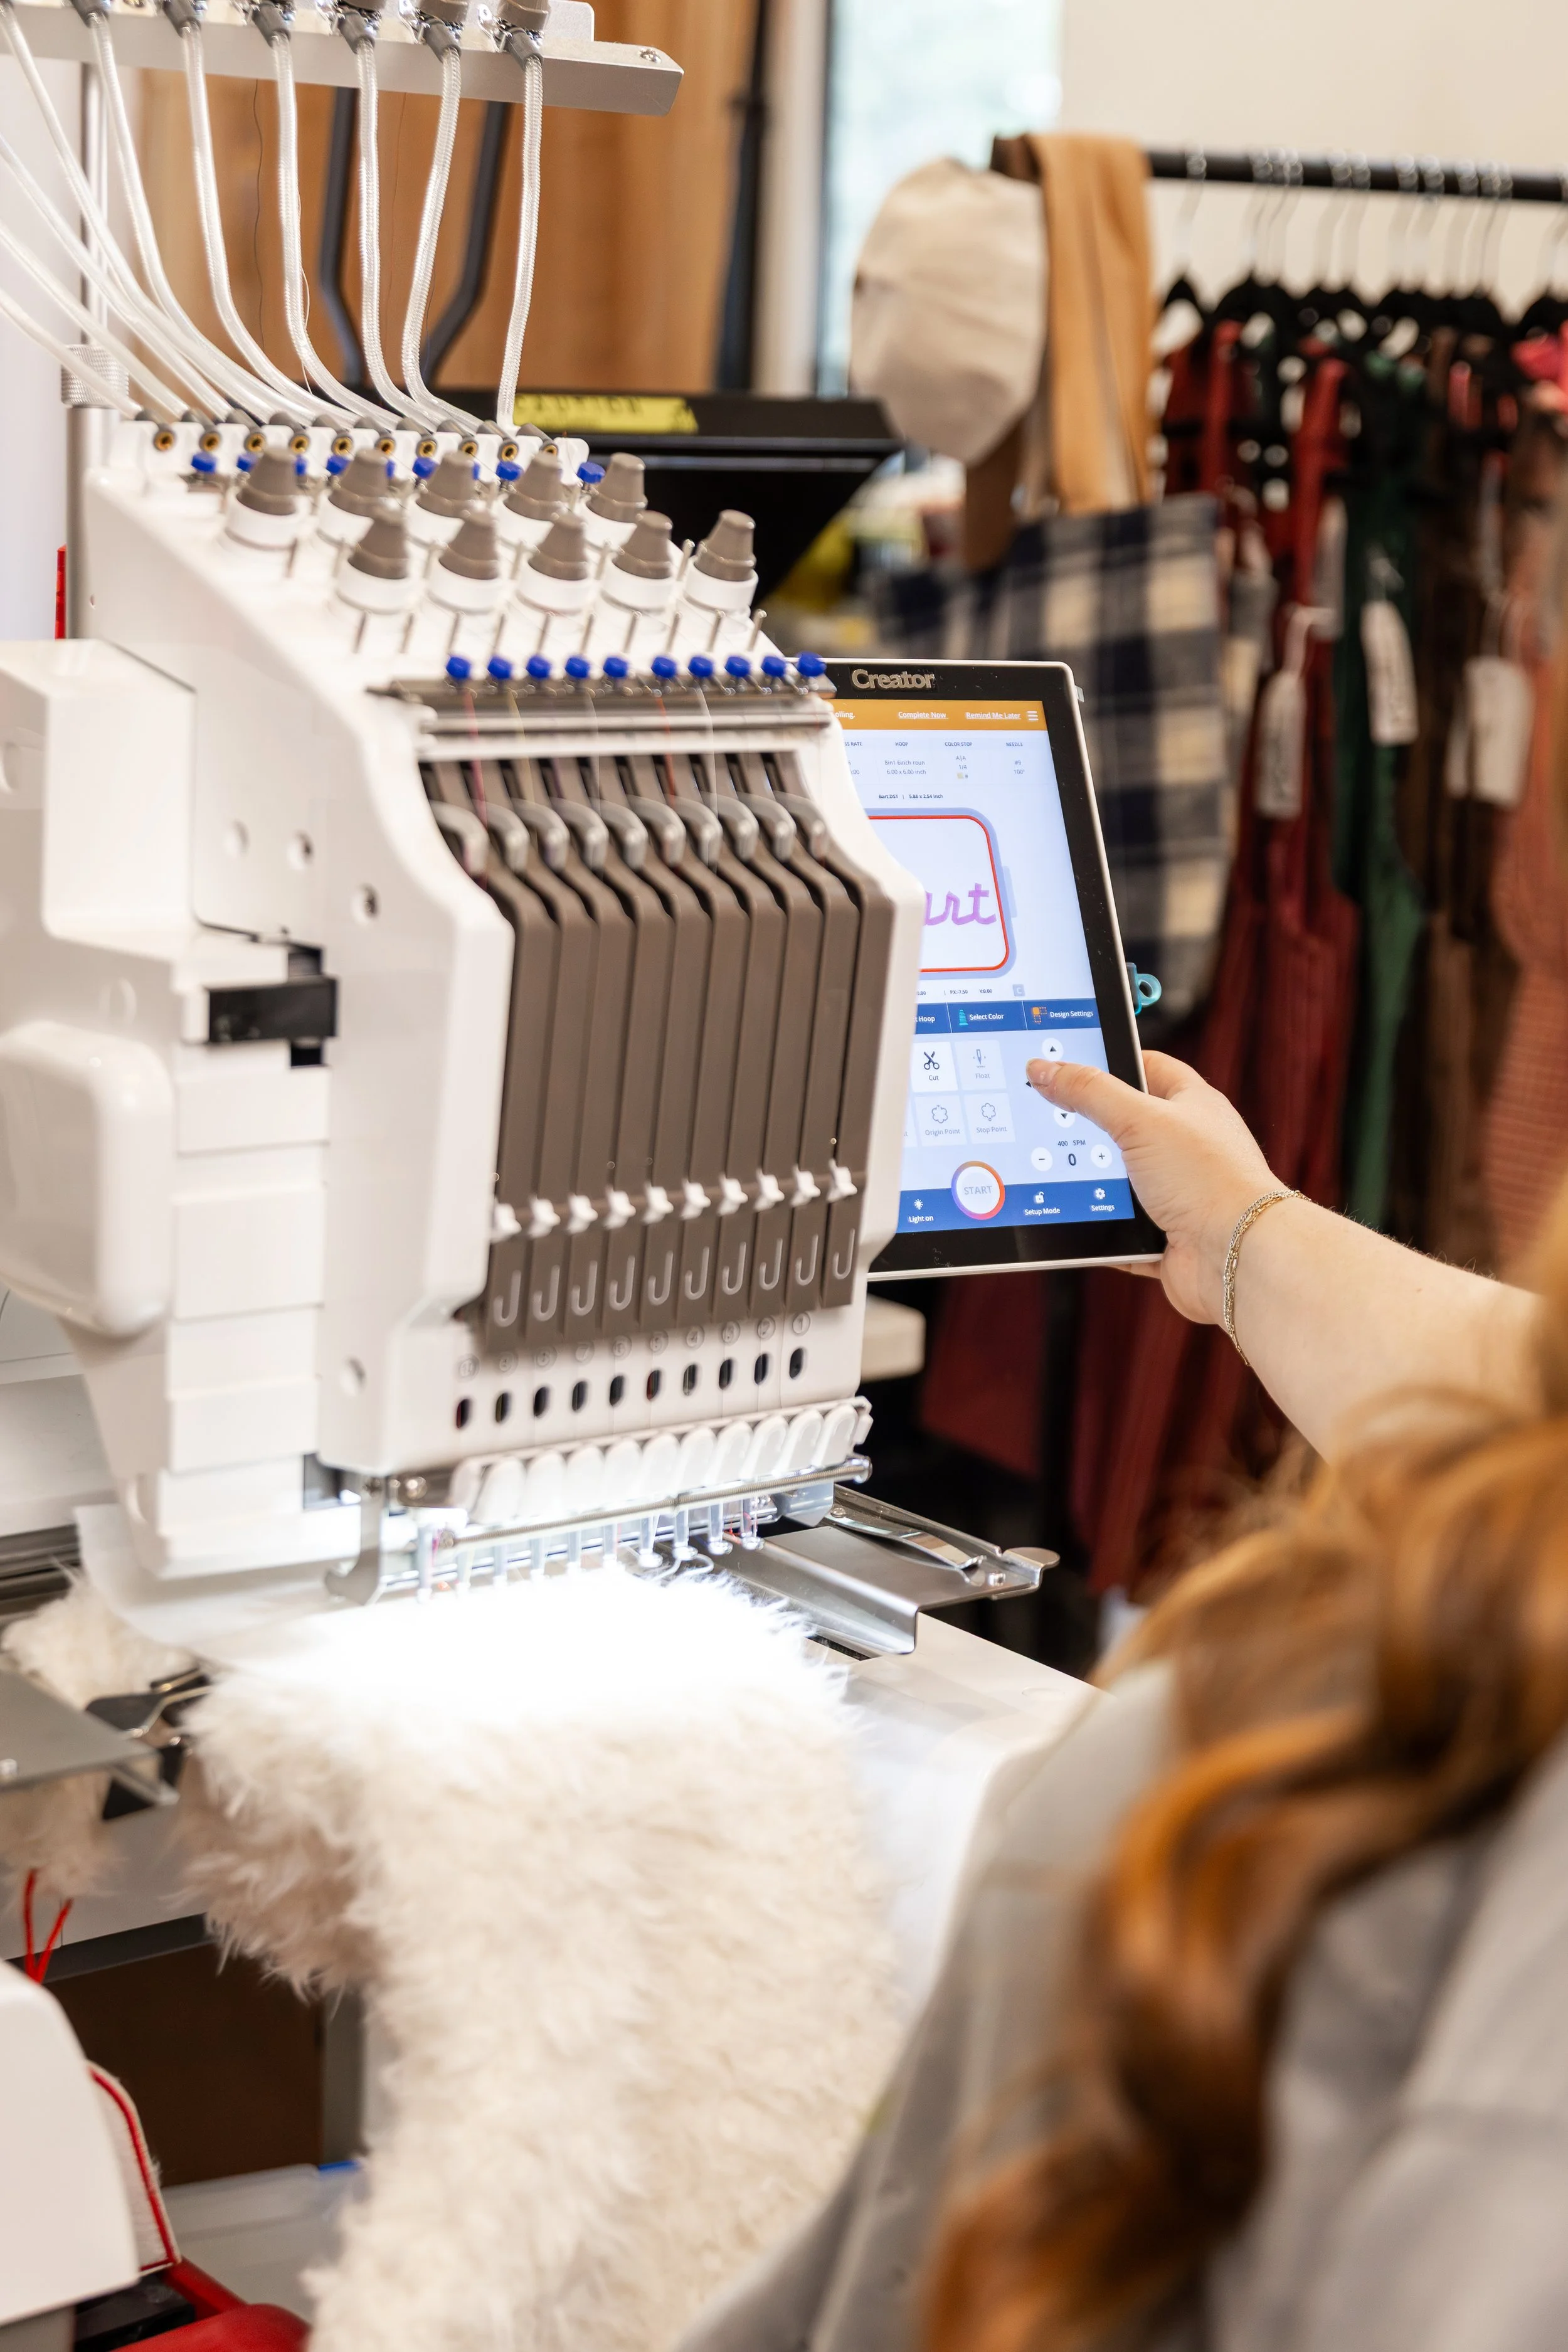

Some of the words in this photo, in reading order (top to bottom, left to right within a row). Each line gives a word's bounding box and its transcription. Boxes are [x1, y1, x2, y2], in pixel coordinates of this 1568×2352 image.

[852, 669, 935, 689] Creator
[898, 711, 930, 719] Complete
[1070, 1010, 1094, 1018] Settings
[1068, 1153, 1077, 1166] 0
[963, 1185, 993, 1195] START
[1024, 1208, 1042, 1216] Setup
[1091, 1204, 1115, 1212] Settings
[909, 1215, 925, 1224] Light
